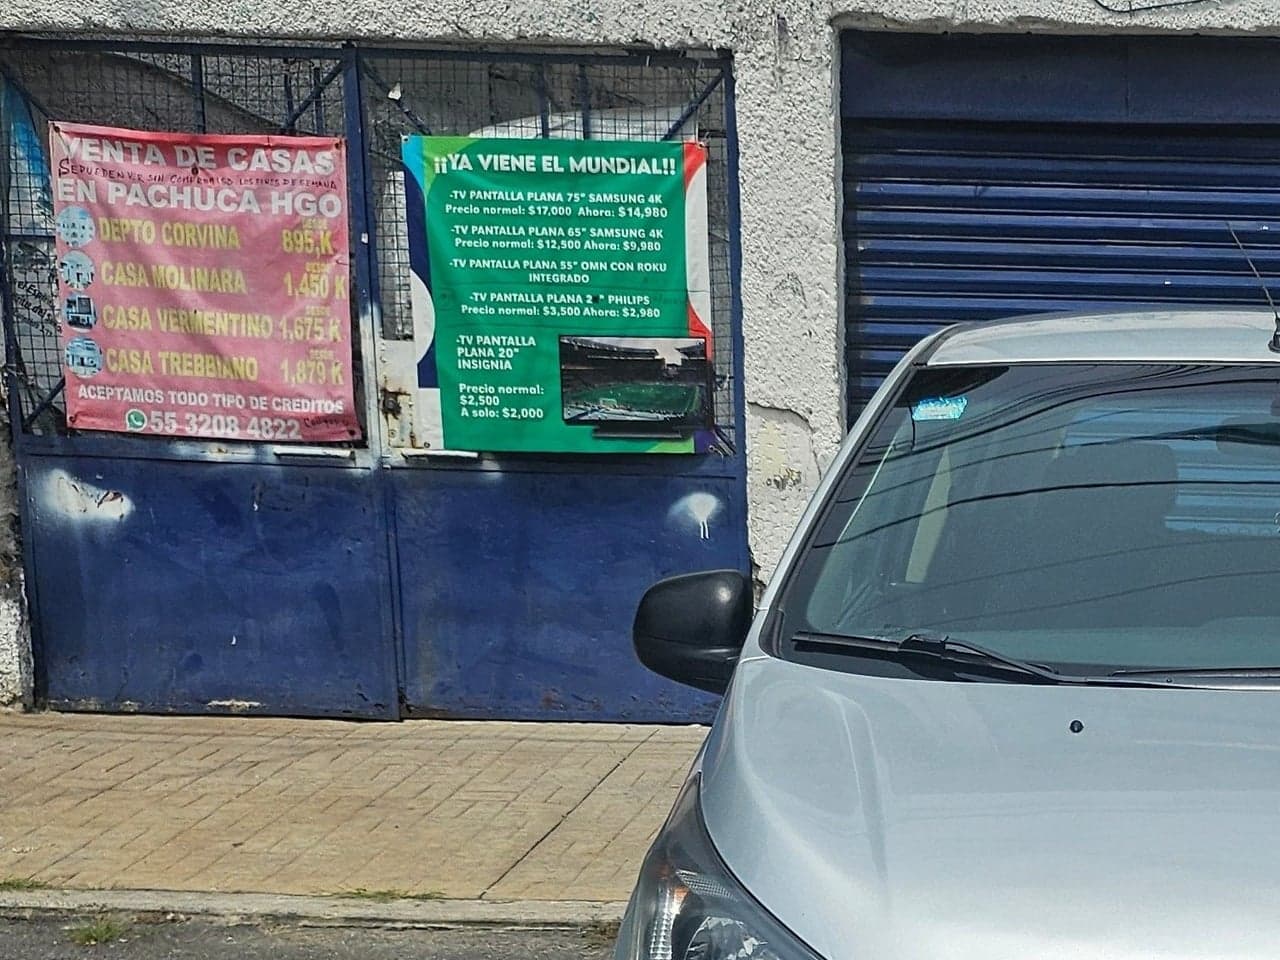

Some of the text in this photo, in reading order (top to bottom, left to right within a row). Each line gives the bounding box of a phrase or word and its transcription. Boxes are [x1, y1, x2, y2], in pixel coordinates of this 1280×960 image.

[61, 137, 335, 177] VENTA DE CASAS
[477, 155, 536, 172] VIENE
[541, 156, 564, 173] EL
[57, 178, 342, 218] EN PACHUCA HGO
[469, 191, 523, 201] PANTALLA
[527, 191, 564, 202] PLANA
[588, 192, 645, 204] SAMSUNG
[648, 194, 663, 204] 4K
[445, 204, 668, 219] Precio normal: $17,000 Ahora: $14,980
[99, 217, 156, 244] DEPTO
[162, 222, 241, 249] CORVINA
[471, 225, 525, 236] PANTALLA
[528, 226, 564, 237] PLANA
[590, 228, 645, 239] SAMSUNG
[649, 229, 664, 239] 4K
[455, 238, 661, 252] Precio normal: $12,500 Ahora: $9,980
[469, 259, 520, 269] PANTALLA
[523, 260, 558, 270] PLANA
[581, 261, 608, 271] OMN
[610, 262, 634, 272] CON
[637, 262, 667, 272] ROKU
[101, 261, 149, 287] CASA
[153, 264, 247, 294] MOLINARA
[334, 274, 347, 299] K
[528, 273, 590, 283] INTEGRADO
[490, 293, 544, 304] PANTALLA
[546, 294, 583, 304] PLANA
[608, 295, 650, 305] PHILIPS
[461, 305, 660, 318] Precio normal: $3,500 Ahora: $2,980
[102, 305, 152, 331] CASA
[157, 308, 273, 338] VERMENTINO
[329, 318, 342, 342] K
[476, 335, 536, 346] PANTALLA
[457, 347, 495, 358] PLANA
[106, 348, 154, 374] CASA
[158, 351, 259, 382] TREBBIANO
[331, 360, 344, 385] K
[457, 359, 512, 370] INSIGNIA
[459, 383, 544, 395] Precio normal:
[78, 385, 344, 414] ACEPTAMOS TODO TIPO DE CREDITOS
[460, 395, 500, 407] $2,500
[461, 407, 544, 419] A solo: $2,000
[150, 411, 177, 433] 55
[185, 414, 240, 436] 3208
[247, 416, 302, 440] 4822
